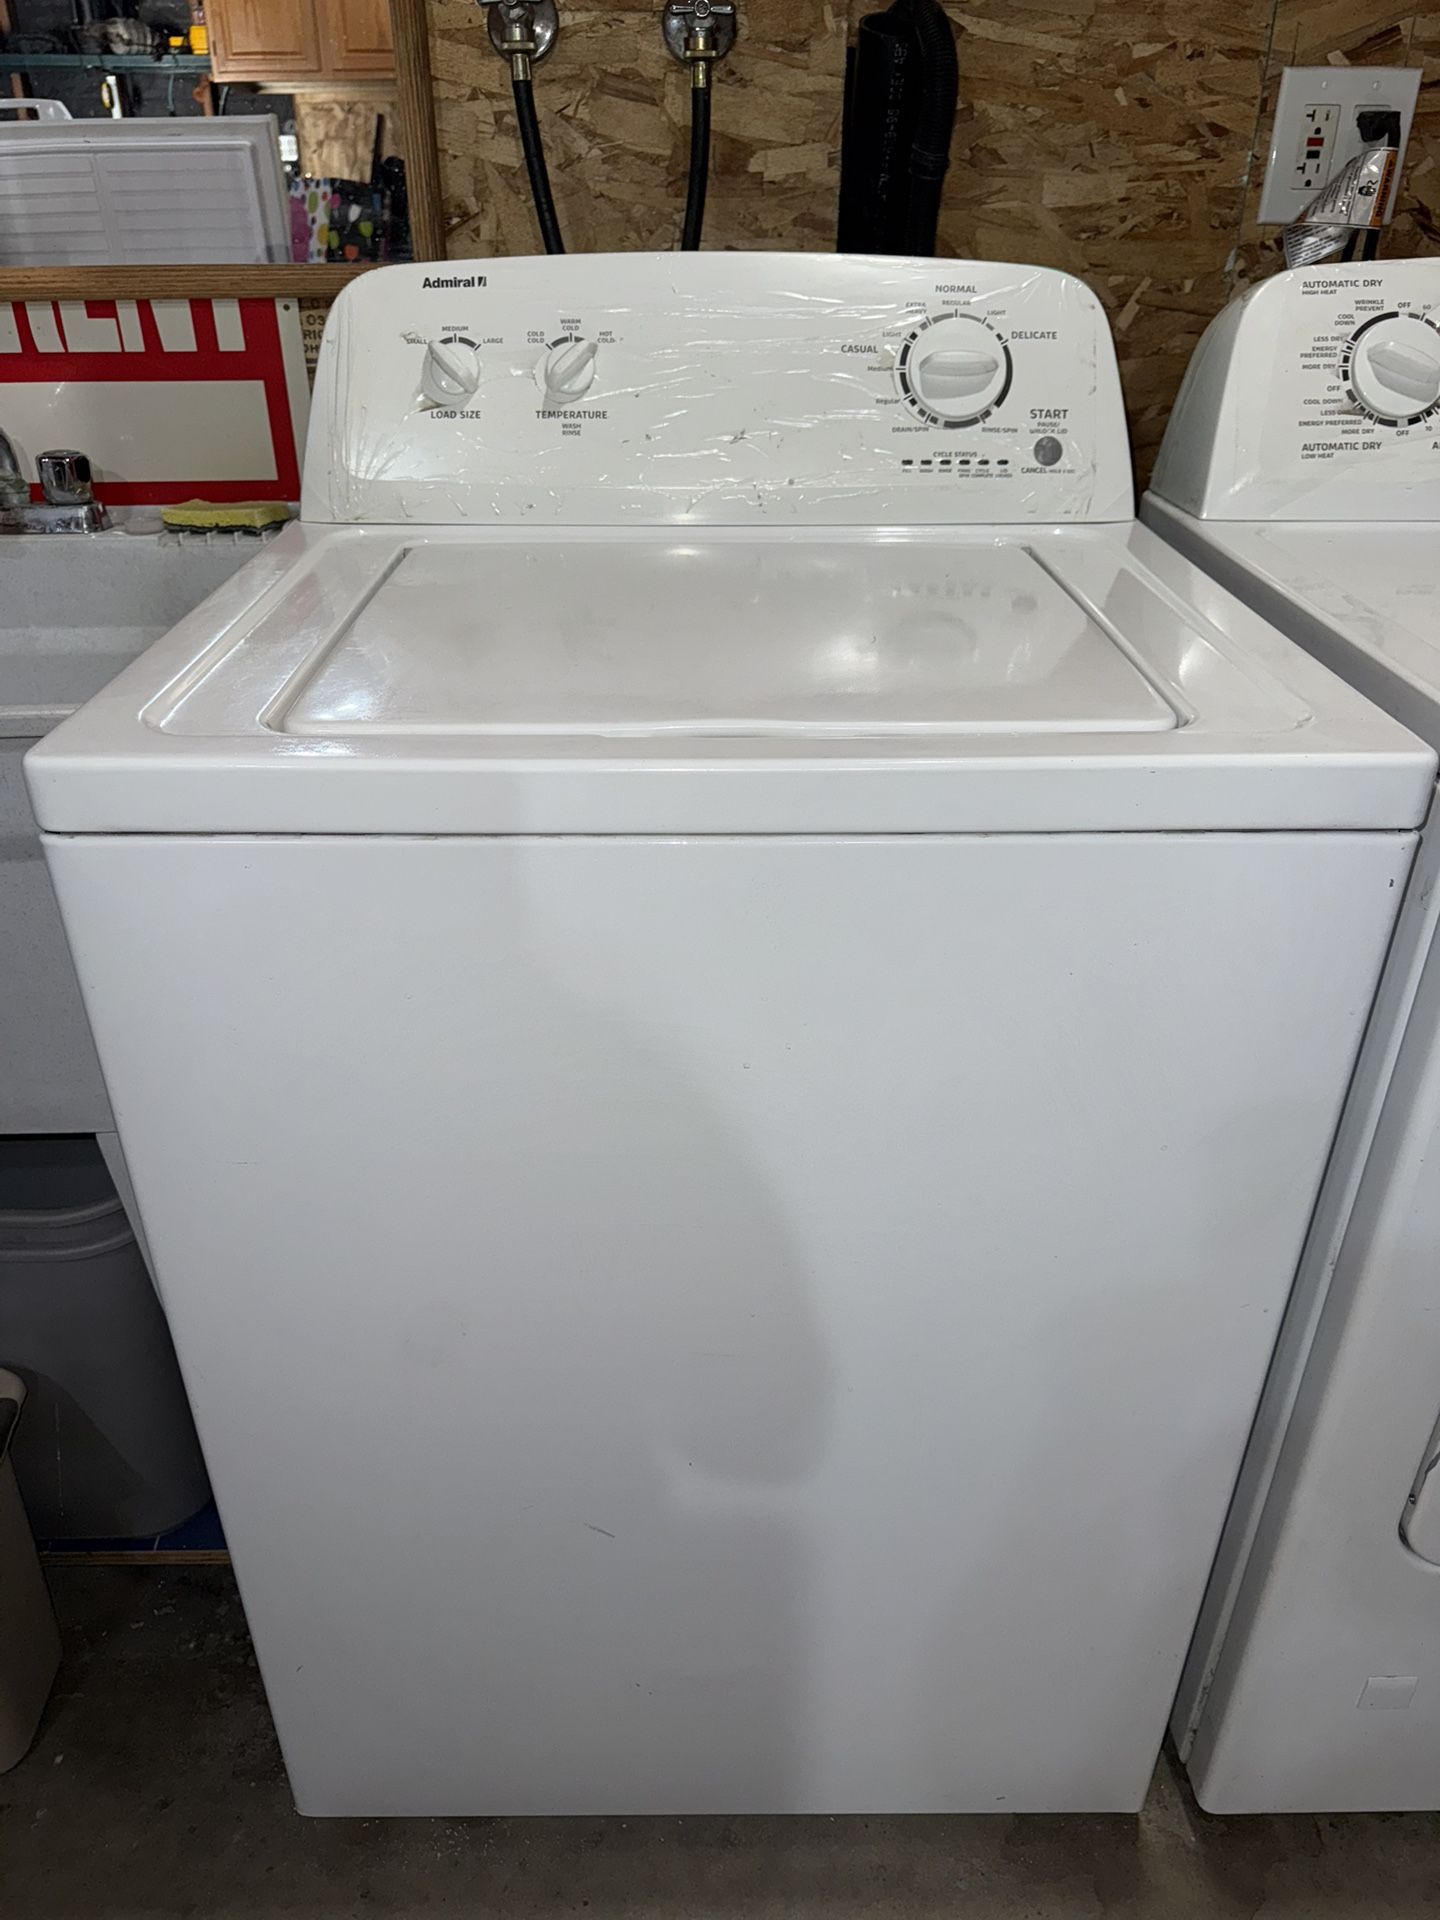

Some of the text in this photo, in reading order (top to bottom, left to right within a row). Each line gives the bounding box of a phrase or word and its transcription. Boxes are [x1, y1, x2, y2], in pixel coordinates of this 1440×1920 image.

[422, 276, 475, 288] Admiral
[1302, 279, 1383, 288] AUTOMATIC DRY
[935, 285, 978, 294] NORMAL
[1011, 331, 1058, 340] DELICATE
[841, 345, 878, 354] CASUAL
[431, 411, 481, 419] LOAD SIZE
[536, 411, 608, 419] TEMPERATURE
[1030, 409, 1069, 419] START
[1301, 442, 1382, 451] AUTOMATIC DRY
